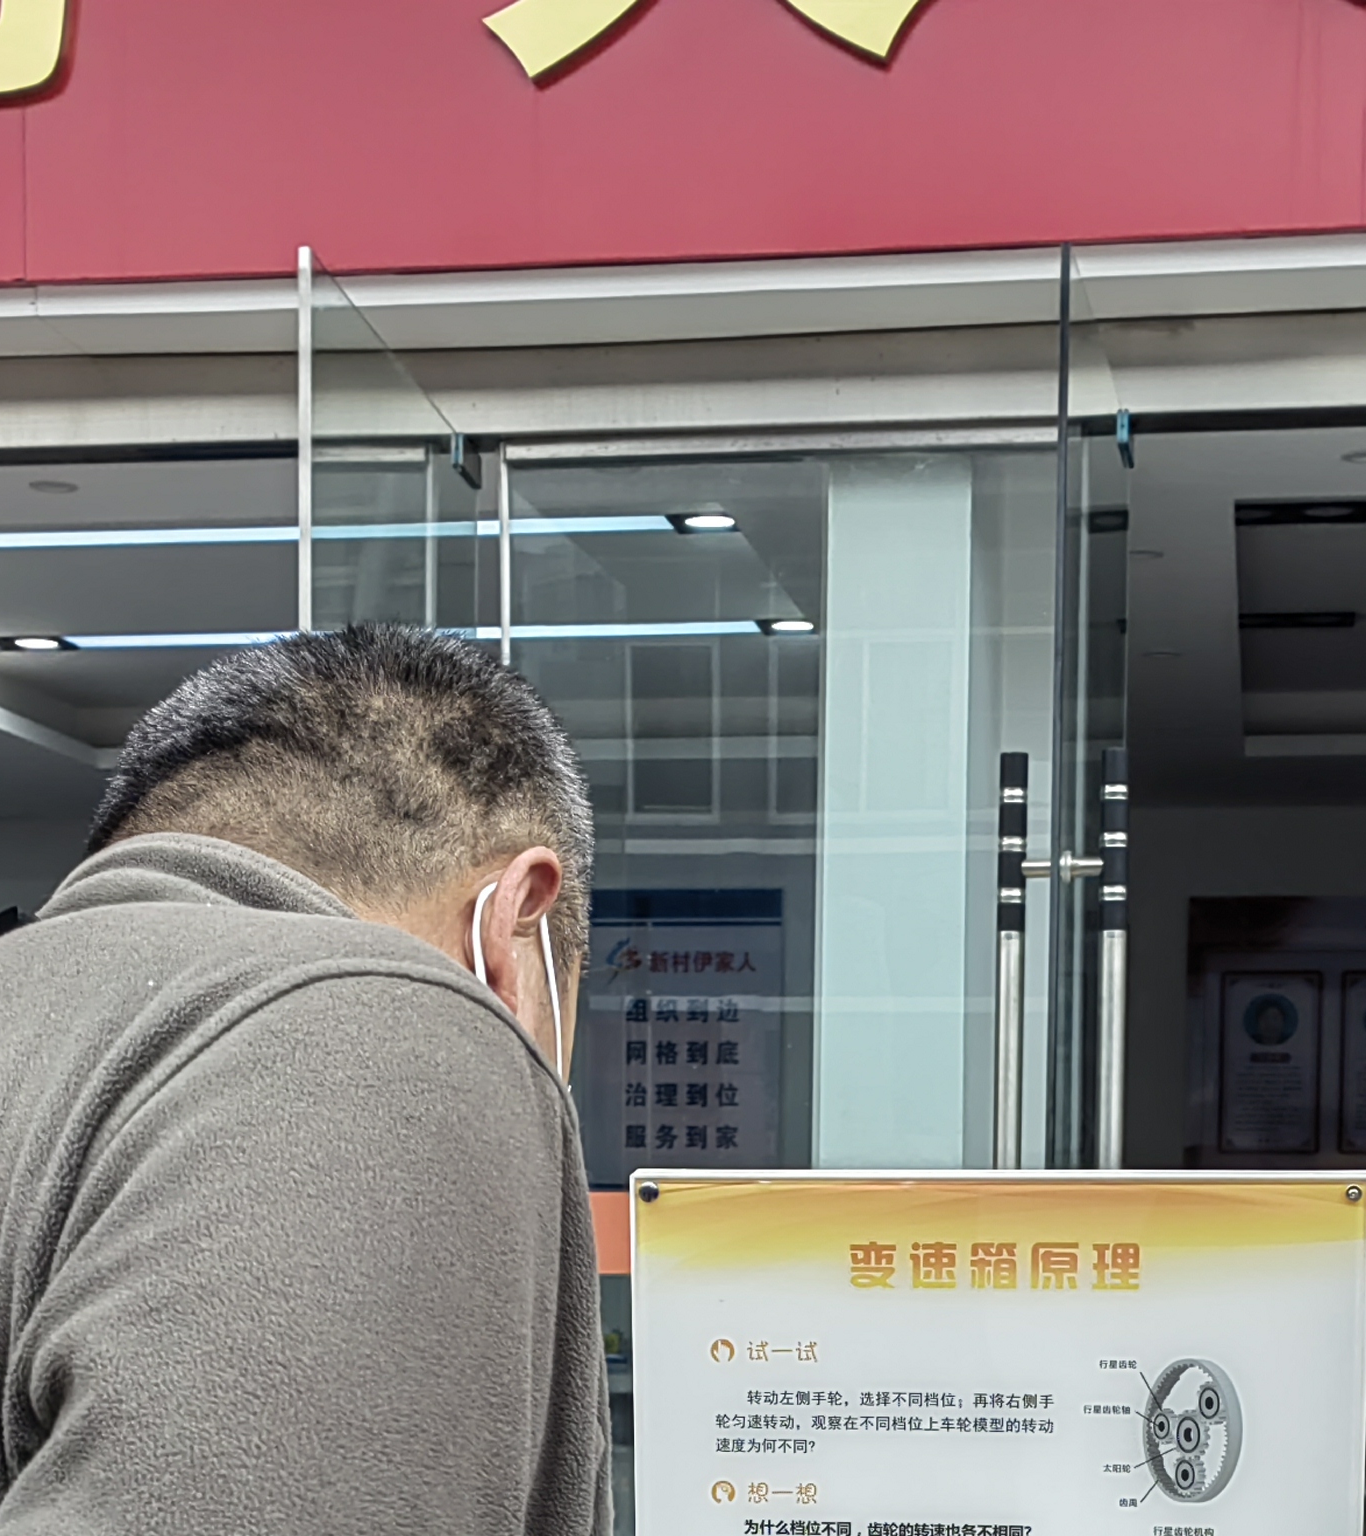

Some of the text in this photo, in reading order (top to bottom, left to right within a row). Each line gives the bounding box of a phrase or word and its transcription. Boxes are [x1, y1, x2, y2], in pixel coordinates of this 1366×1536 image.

[649, 951, 756, 974] 新村伊家人
[625, 998, 740, 1023] 组织到边
[625, 1040, 740, 1065] 网格到底
[625, 1083, 740, 1108] 治理到位
[625, 1125, 739, 1150] 服务到家
[849, 1241, 1141, 1291] 变速箱原理
[747, 1341, 818, 1362] 试一试
[716, 1438, 815, 1454] 速度为何不同?
[747, 1482, 818, 1504] 想一想
